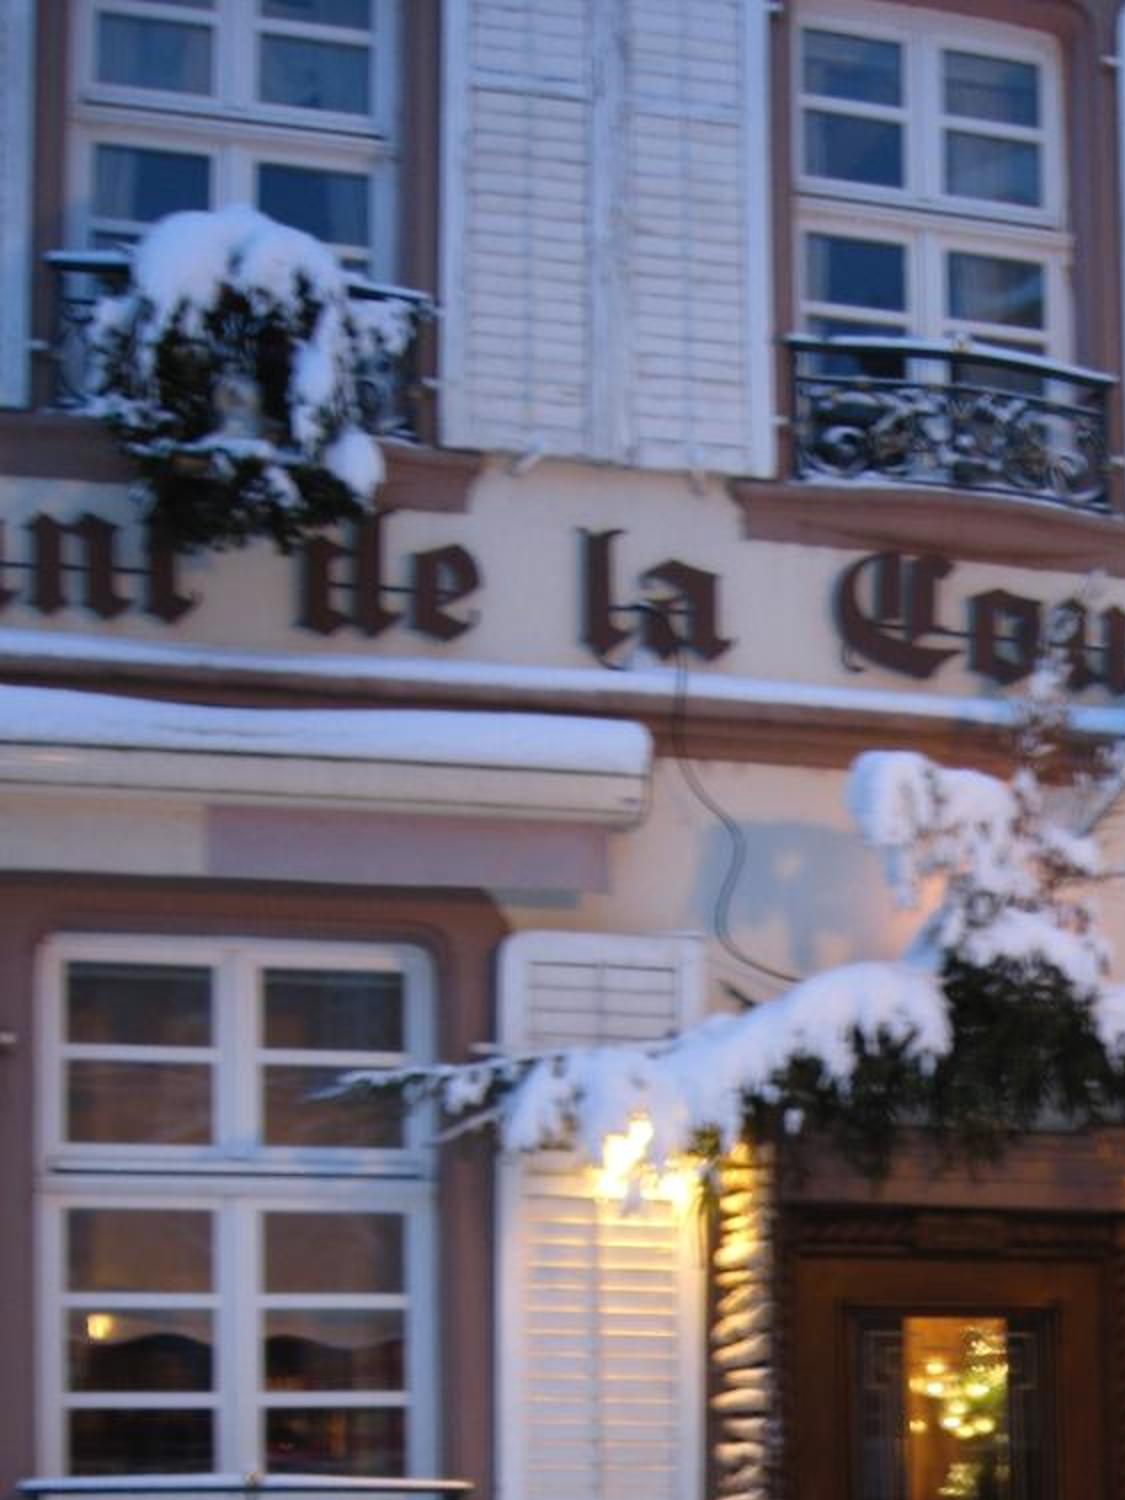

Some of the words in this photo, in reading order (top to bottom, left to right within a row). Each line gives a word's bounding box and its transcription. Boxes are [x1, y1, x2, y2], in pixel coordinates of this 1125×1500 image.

[0, 510, 202, 626] nt
[293, 510, 482, 642] de
[574, 526, 737, 664] la
